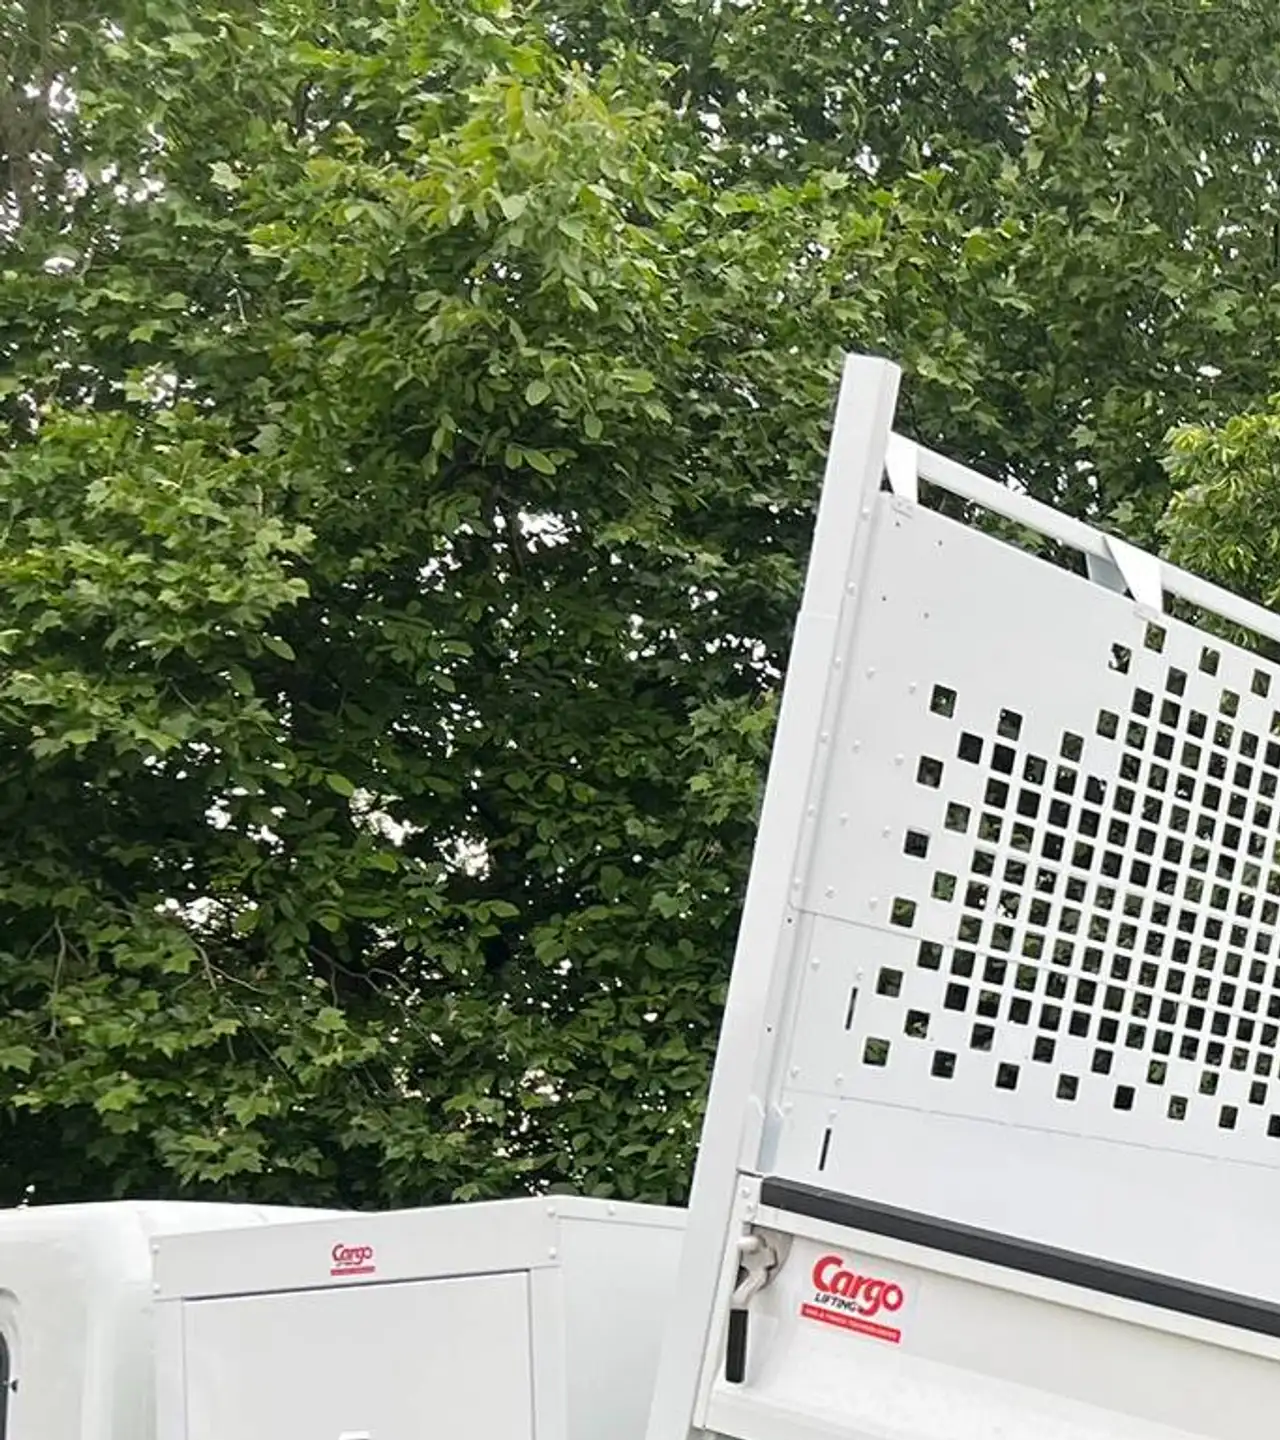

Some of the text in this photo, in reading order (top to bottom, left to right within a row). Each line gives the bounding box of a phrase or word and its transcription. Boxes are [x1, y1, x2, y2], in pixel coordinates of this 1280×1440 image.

[332, 1243, 373, 1265] Cargo
[812, 1255, 904, 1317] Cargo
[814, 1293, 857, 1313] LIFTING
